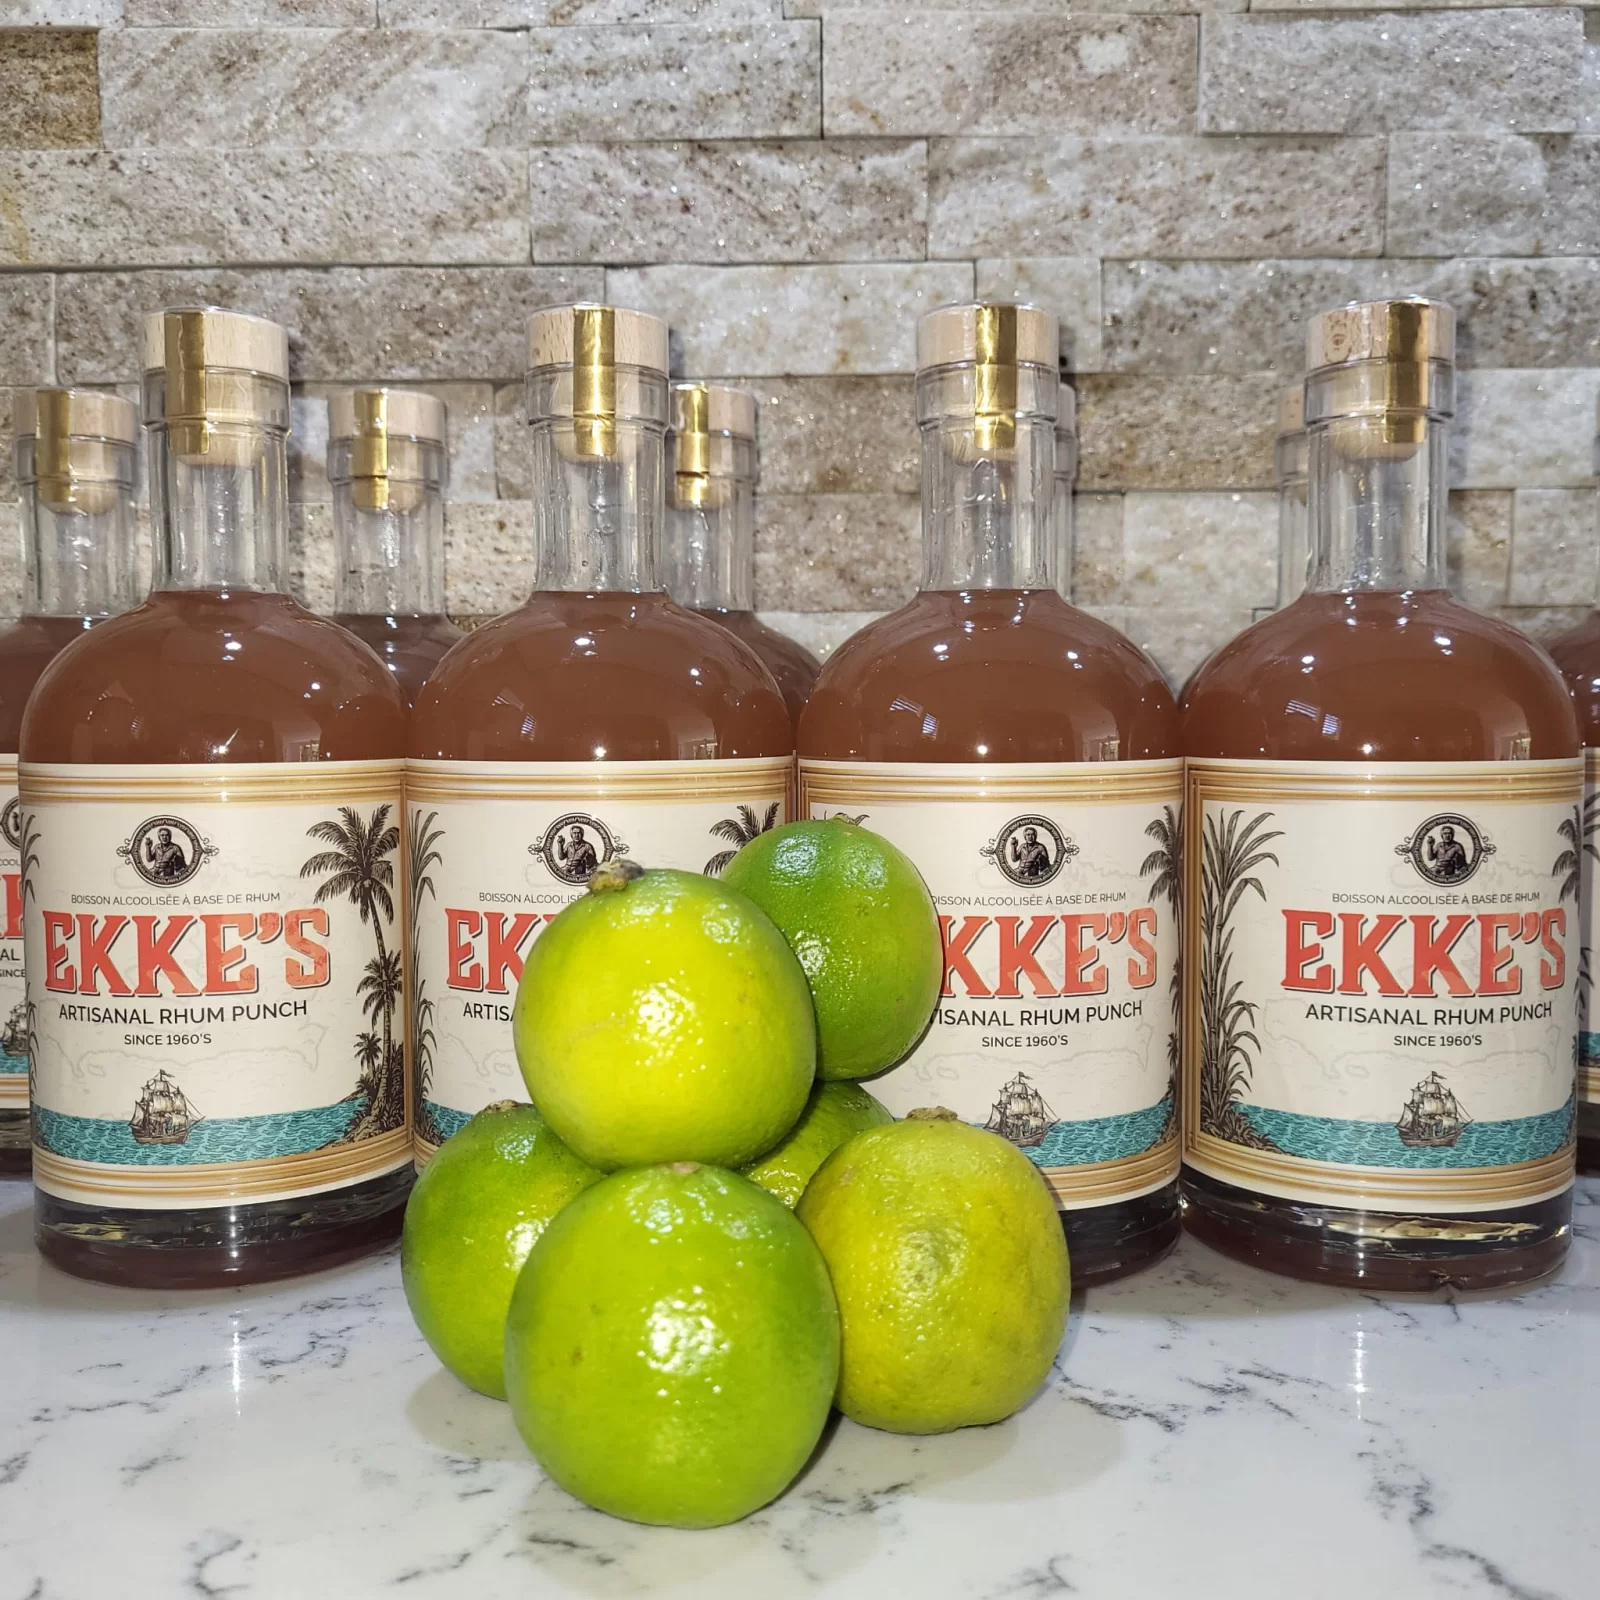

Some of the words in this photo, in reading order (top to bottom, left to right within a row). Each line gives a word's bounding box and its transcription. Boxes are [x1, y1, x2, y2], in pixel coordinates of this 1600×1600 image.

[71, 894, 110, 905] BOISSON
[112, 894, 179, 906] ALCOOLISÉE
[193, 895, 223, 905] BASE
[226, 894, 243, 904] DE
[245, 892, 281, 903] RHUM
[479, 892, 521, 904] BOISSON
[523, 892, 584, 904] ALCOOLIS
[931, 895, 972, 906] OISSON
[974, 894, 1043, 906] ALCOOLISÉE
[1055, 894, 1082, 905] BASE
[1084, 894, 1098, 904] DE
[1099, 892, 1127, 902] RHUM
[1332, 893, 1385, 905] BOISSON
[1387, 893, 1459, 905] ALCOOLISÉE
[1471, 893, 1498, 904] BASE
[1500, 893, 1513, 904] DE
[1515, 891, 1540, 903] RHUM
[42, 908, 330, 997] EKKE'S
[938, 907, 1158, 999] KKE'S
[1280, 907, 1566, 998] EKKE'S
[59, 1004, 154, 1024] ARTISANAL
[159, 1006, 225, 1024] RHUM
[232, 1000, 307, 1021] PUNCH
[463, 1001, 514, 1021] ARTIS
[930, 1008, 1014, 1026] TISANAL
[1020, 1007, 1080, 1026] RHUM
[1086, 1000, 1142, 1022] PUNCH
[1305, 1003, 1428, 1025] ARTISANAL
[1434, 1007, 1494, 1025] RHUM
[1500, 1001, 1552, 1023] PUNCH
[124, 1034, 163, 1045] SINCE
[167, 1033, 212, 1045] 1960'S
[981, 1036, 1022, 1048] SINCE
[1025, 1034, 1069, 1047] 1960'S
[1393, 1035, 1436, 1046] SINCE
[1439, 1034, 1482, 1046] 1960'S
